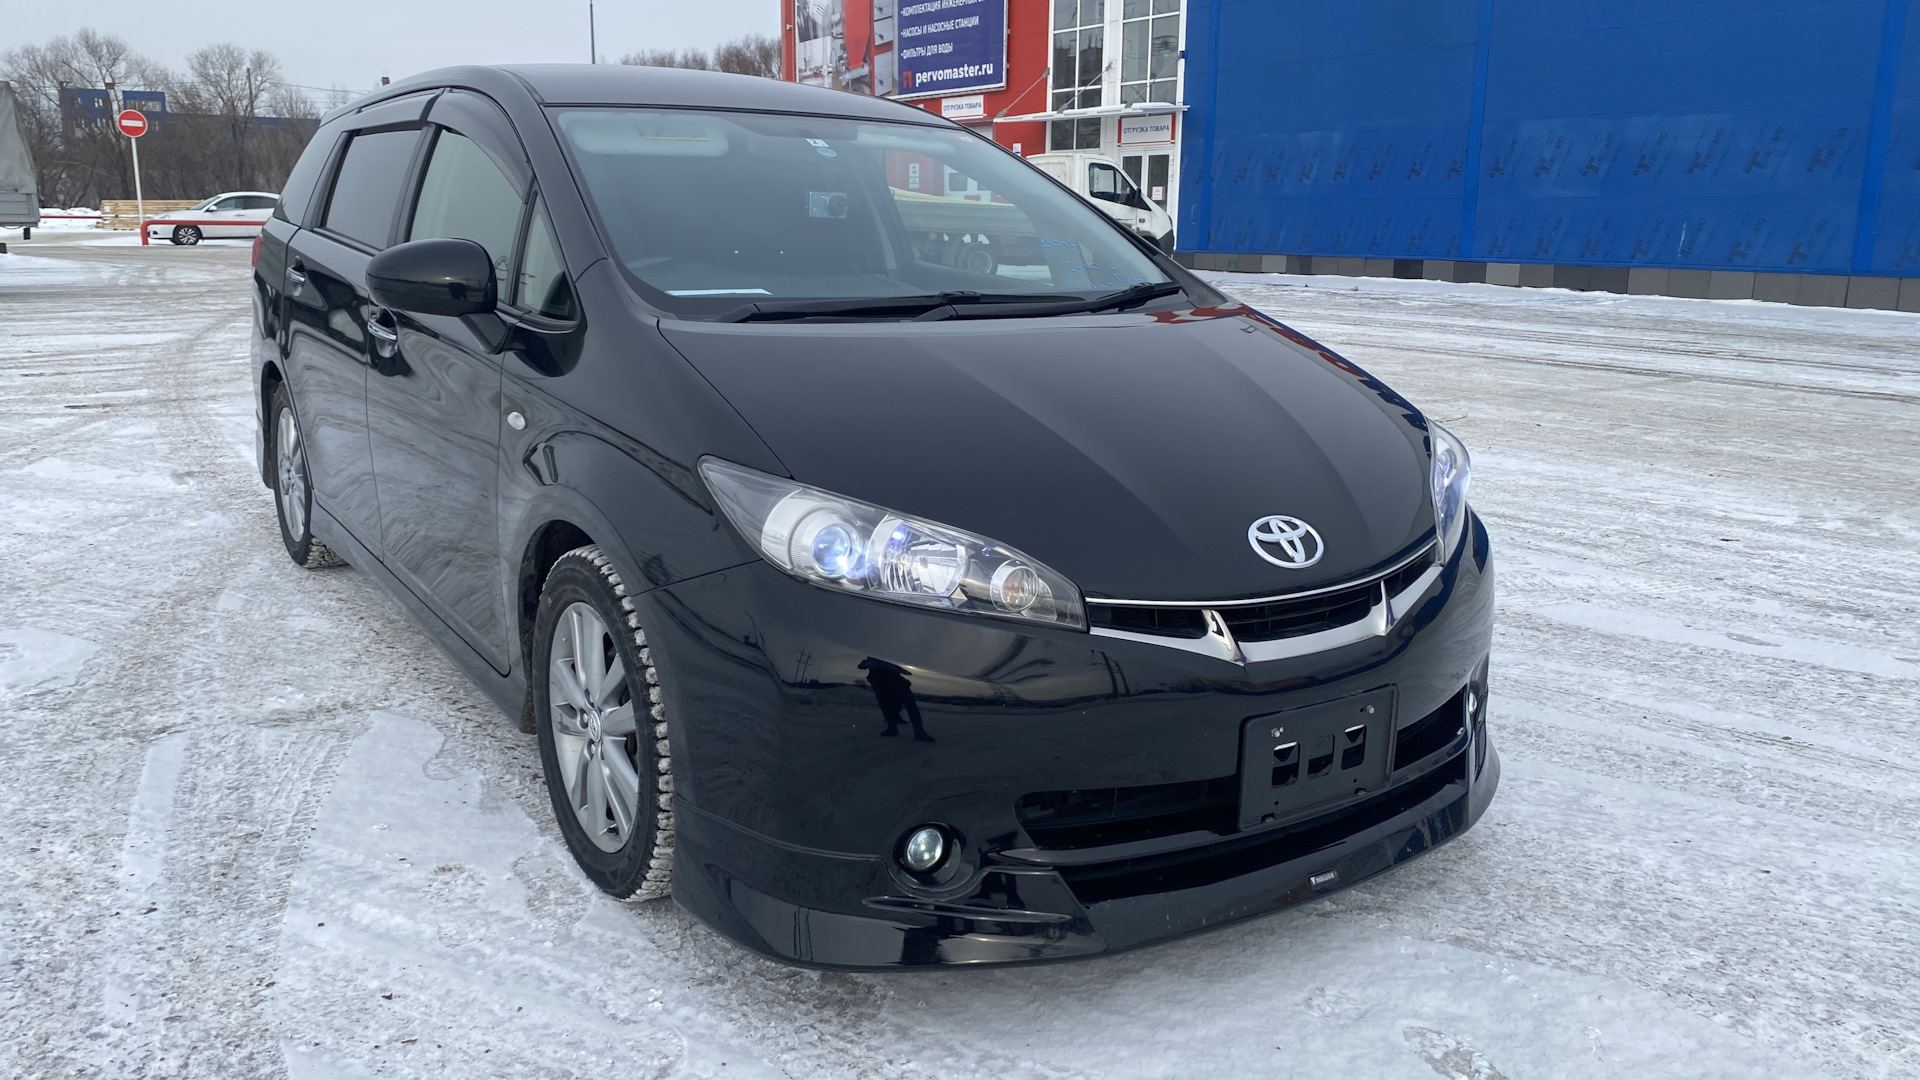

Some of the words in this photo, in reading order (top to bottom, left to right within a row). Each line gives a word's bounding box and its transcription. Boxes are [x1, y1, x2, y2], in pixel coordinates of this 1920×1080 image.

[928, 19, 955, 34] НАСОСНЫЕ
[955, 15, 980, 28] СТАНЦИИ
[926, 44, 938, 56] ДЛЯ
[938, 42, 953, 54] ВОДЫ
[915, 63, 994, 87] pervomaster.ru
[964, 102, 982, 110] ТОВАРА
[1123, 126, 1149, 134] ОТГРУЗКА
[1149, 124, 1170, 132] ТОВАРА
